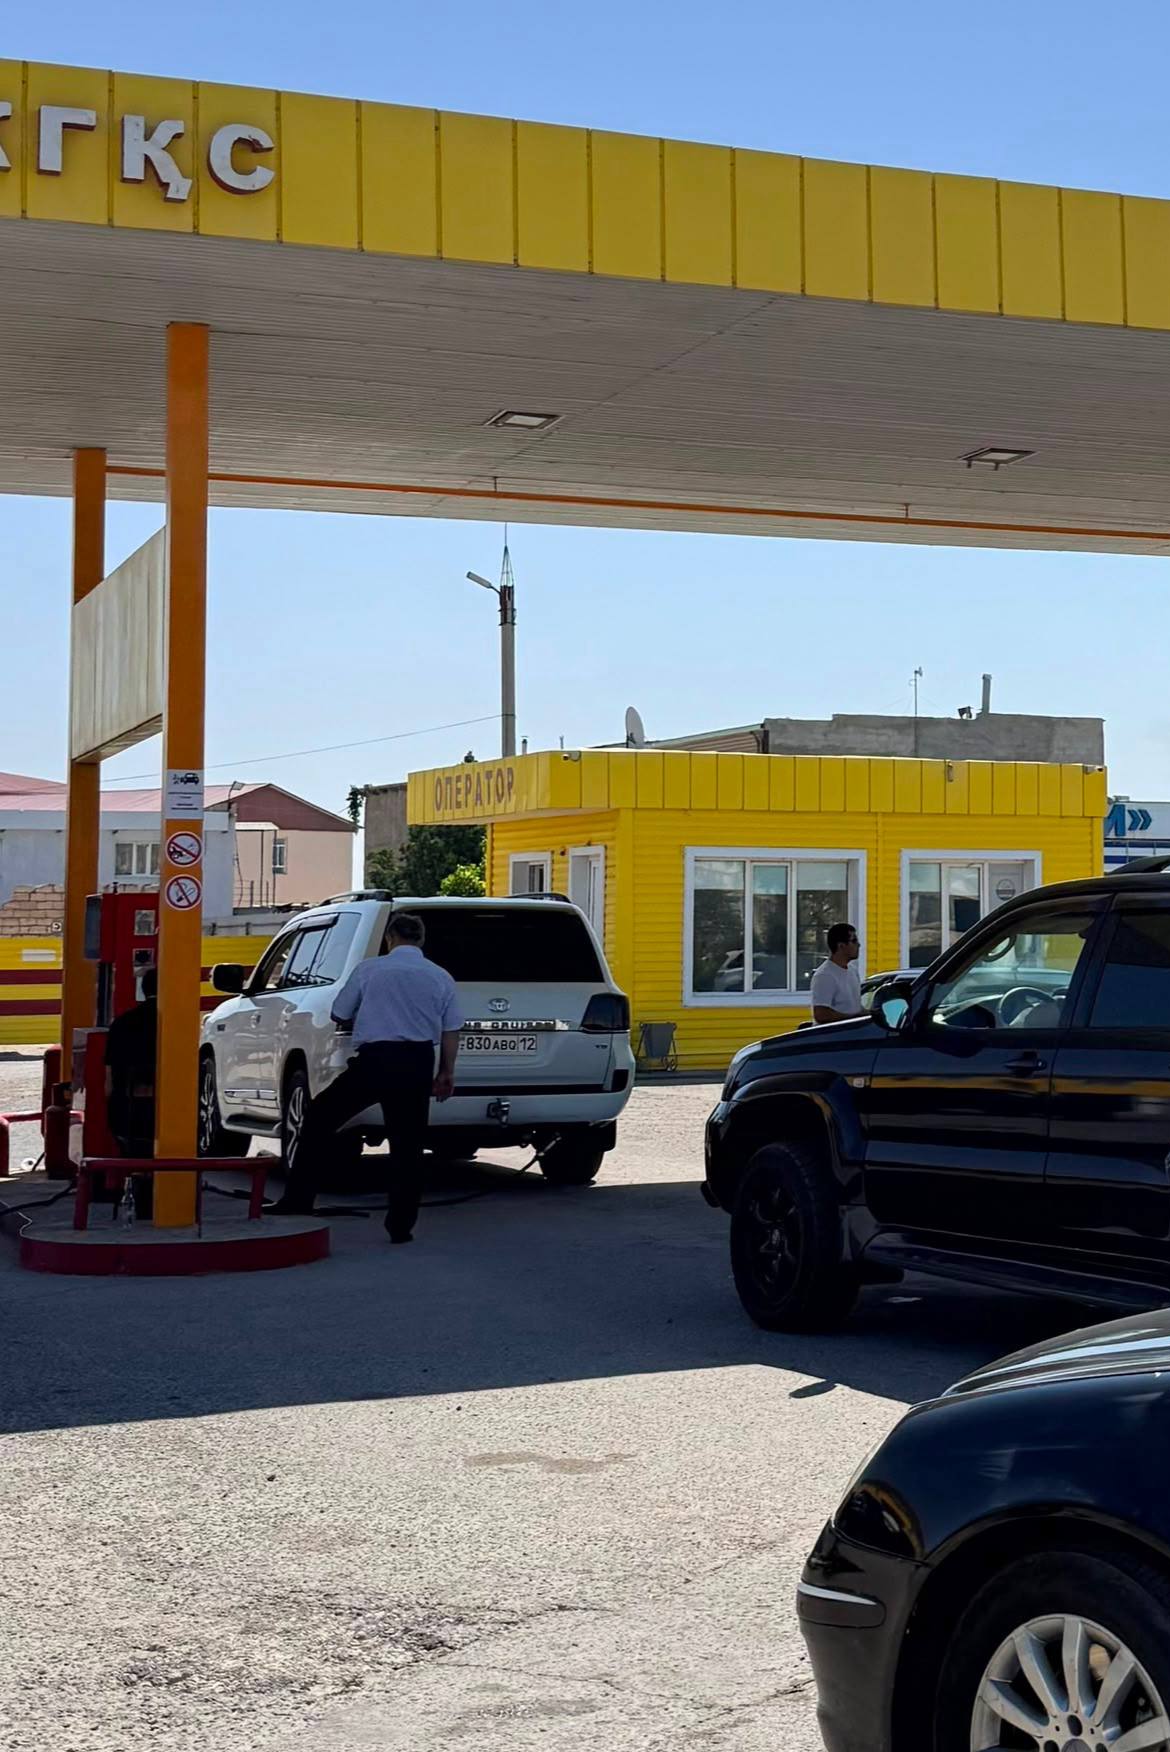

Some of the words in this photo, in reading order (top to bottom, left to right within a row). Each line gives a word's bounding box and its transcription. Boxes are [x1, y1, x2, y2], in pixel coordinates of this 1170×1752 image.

[0, 101, 275, 202] ГҚС
[435, 767, 514, 811] ОПЕРАТОР
[519, 1037, 537, 1051] 12
